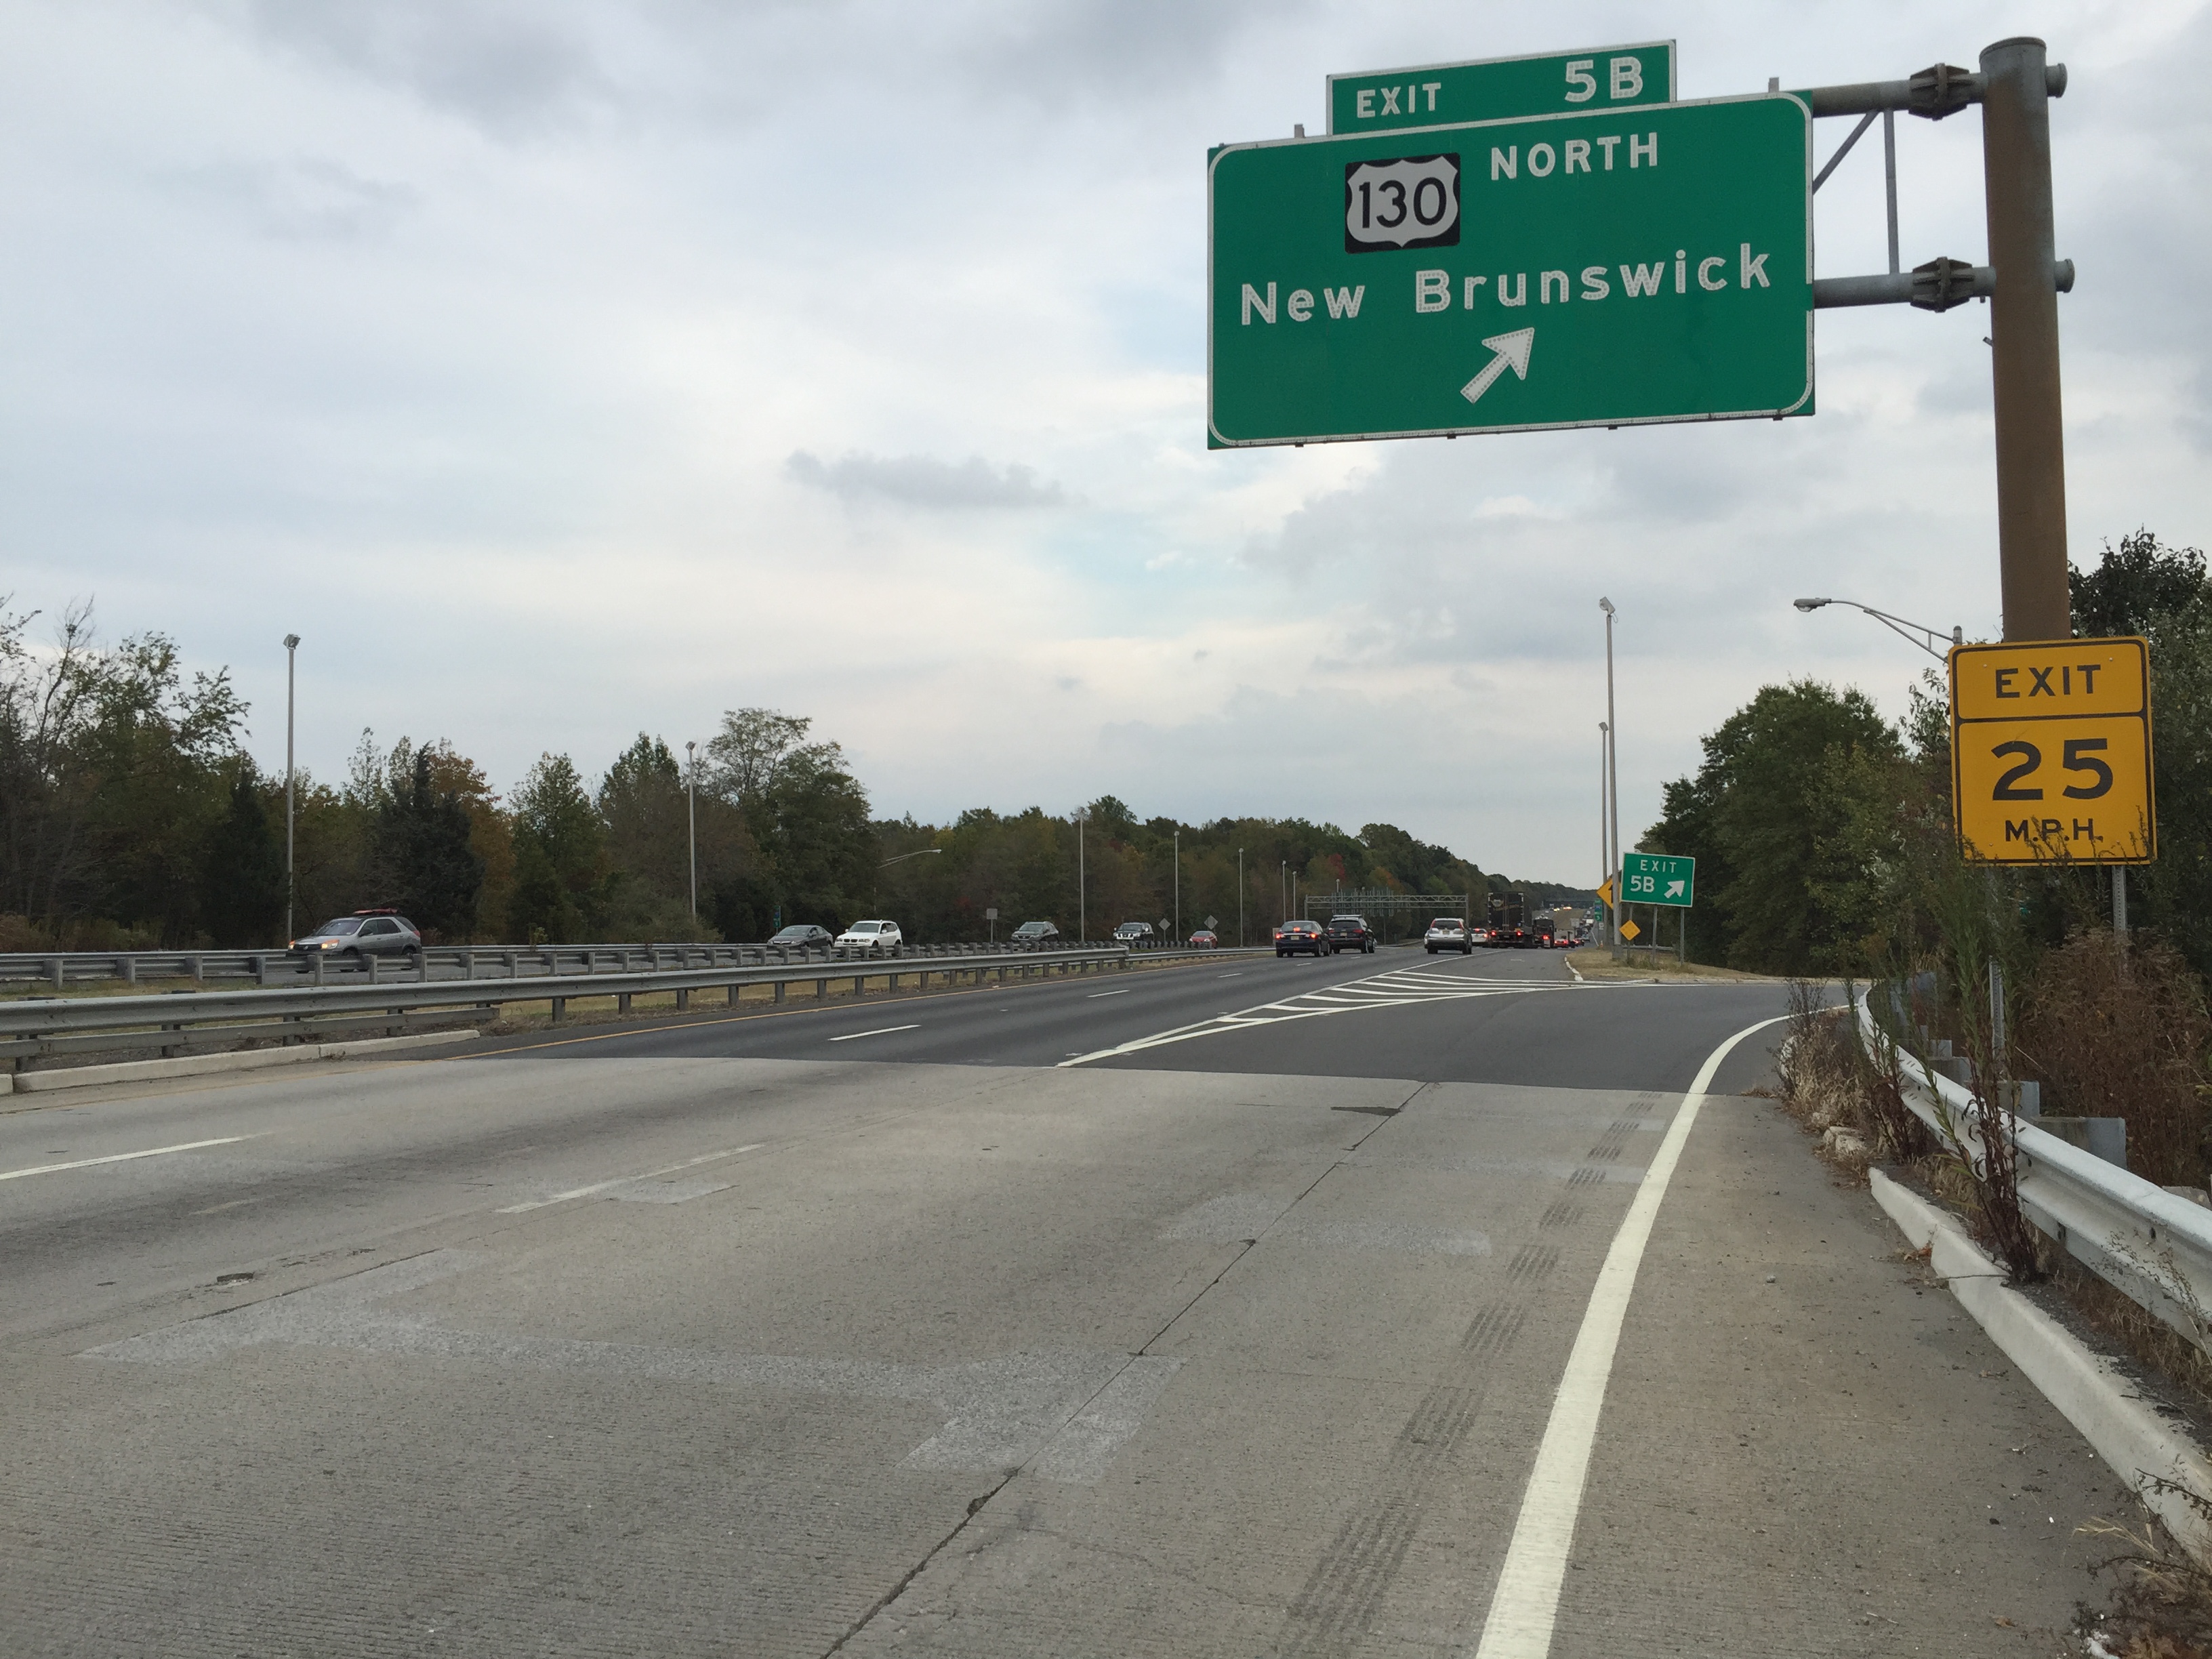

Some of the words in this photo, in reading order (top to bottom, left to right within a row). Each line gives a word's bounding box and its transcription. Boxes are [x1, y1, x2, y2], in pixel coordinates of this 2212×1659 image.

[1357, 82, 1441, 119] EXIT
[1564, 56, 1643, 103] 5B
[1491, 131, 1658, 181] NORTH
[1358, 177, 1447, 229] 130
[1241, 281, 1366, 326] New
[1415, 243, 1771, 314] Brunswick
[1995, 663, 2102, 699] EXIT
[1990, 737, 2114, 802] 25
[1630, 875, 1655, 893] 5B
[1640, 859, 1677, 874] EXIT
